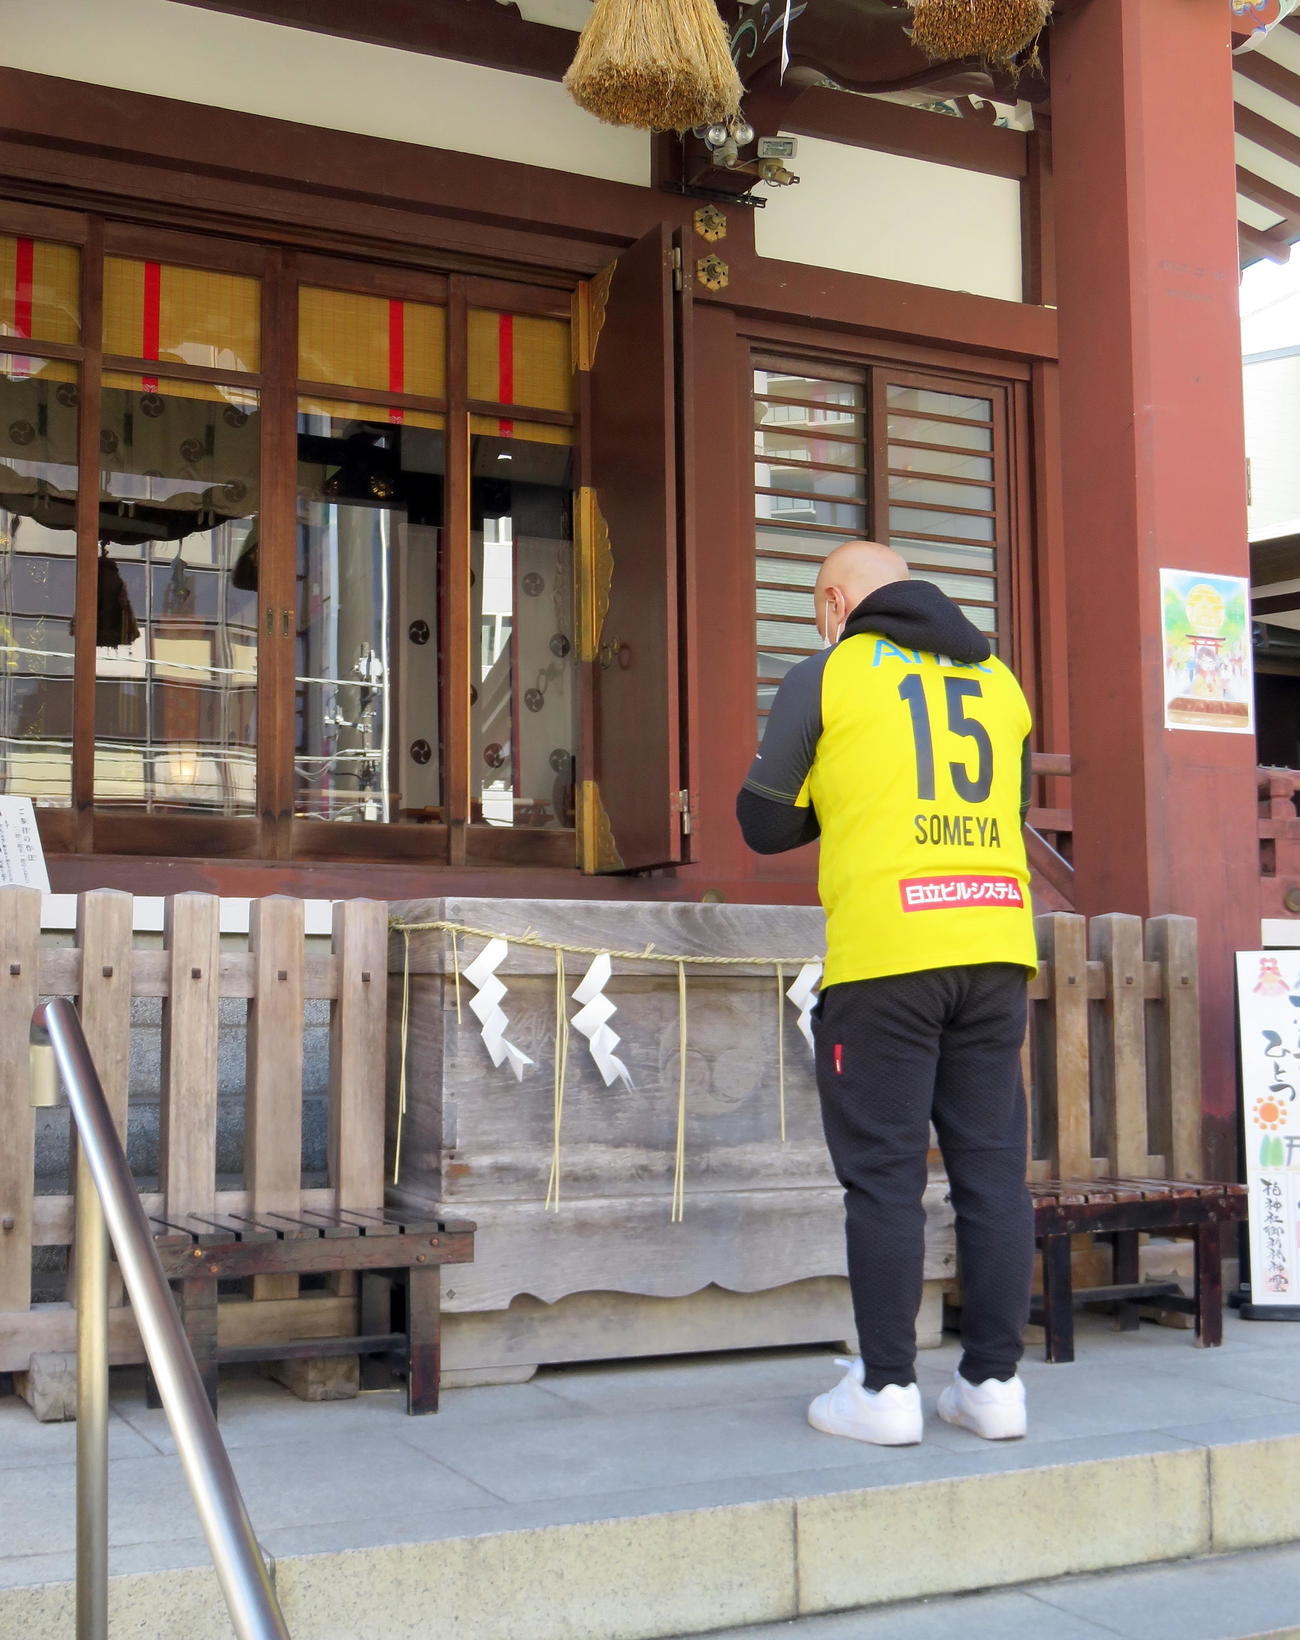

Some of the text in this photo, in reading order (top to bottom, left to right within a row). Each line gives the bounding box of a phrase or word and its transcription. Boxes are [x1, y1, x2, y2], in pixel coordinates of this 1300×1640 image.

[897, 673, 994, 803] 15
[914, 813, 1001, 848] SOMEYA
[904, 881, 1021, 905] 日立ビルシステム
[1261, 1029, 1297, 1102] ひとつ
